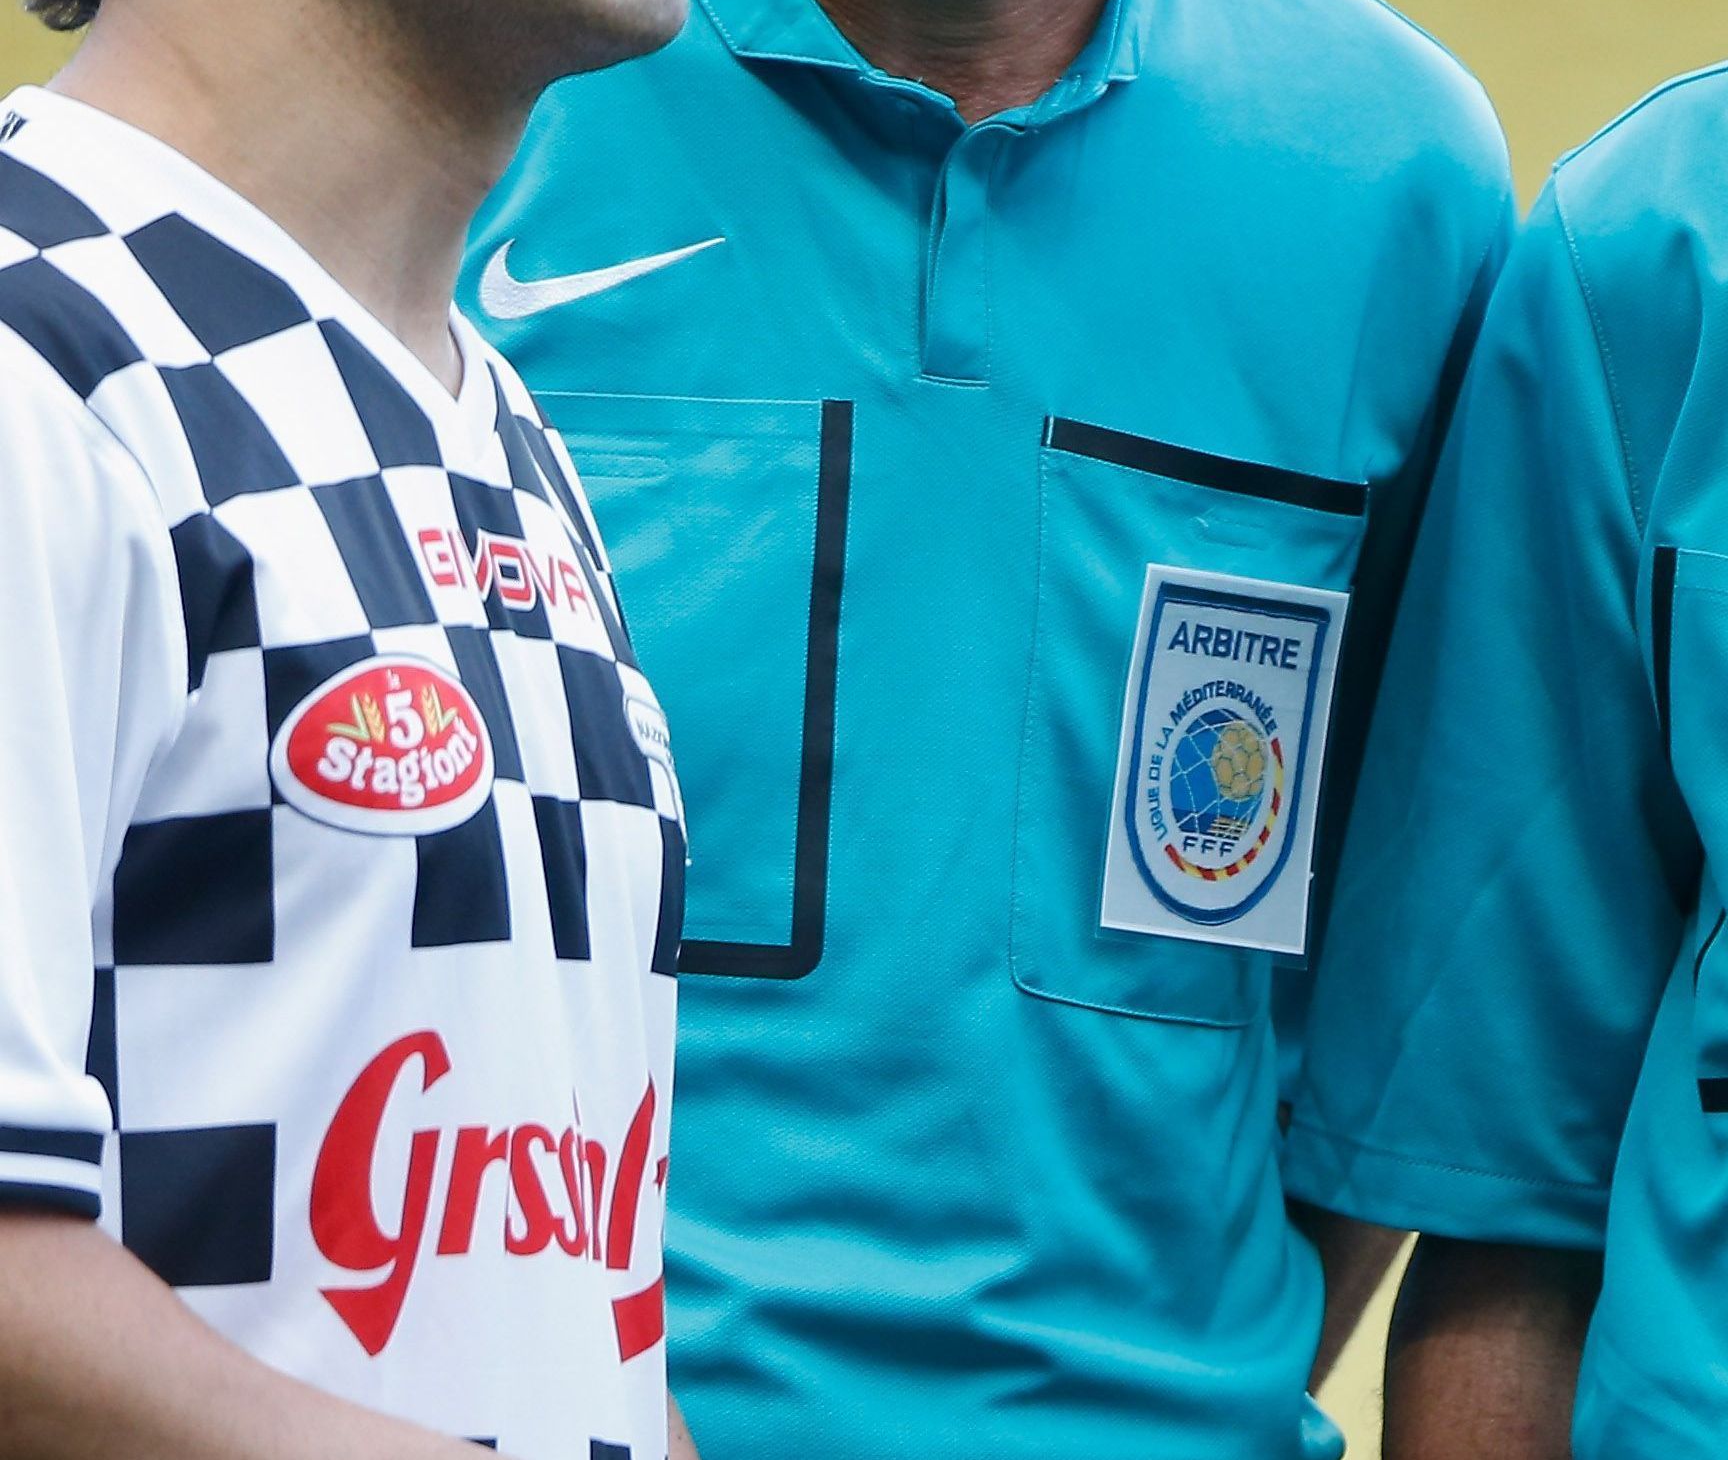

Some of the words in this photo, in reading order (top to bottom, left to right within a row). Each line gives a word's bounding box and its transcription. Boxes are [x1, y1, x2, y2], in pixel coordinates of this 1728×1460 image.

[418, 529, 595, 621] GIVOVA
[1168, 621, 1302, 671] ARBITRE
[384, 690, 424, 749] 5
[1156, 726, 1174, 750] LA
[317, 715, 478, 807] Stagioni
[1149, 754, 1164, 781] DE
